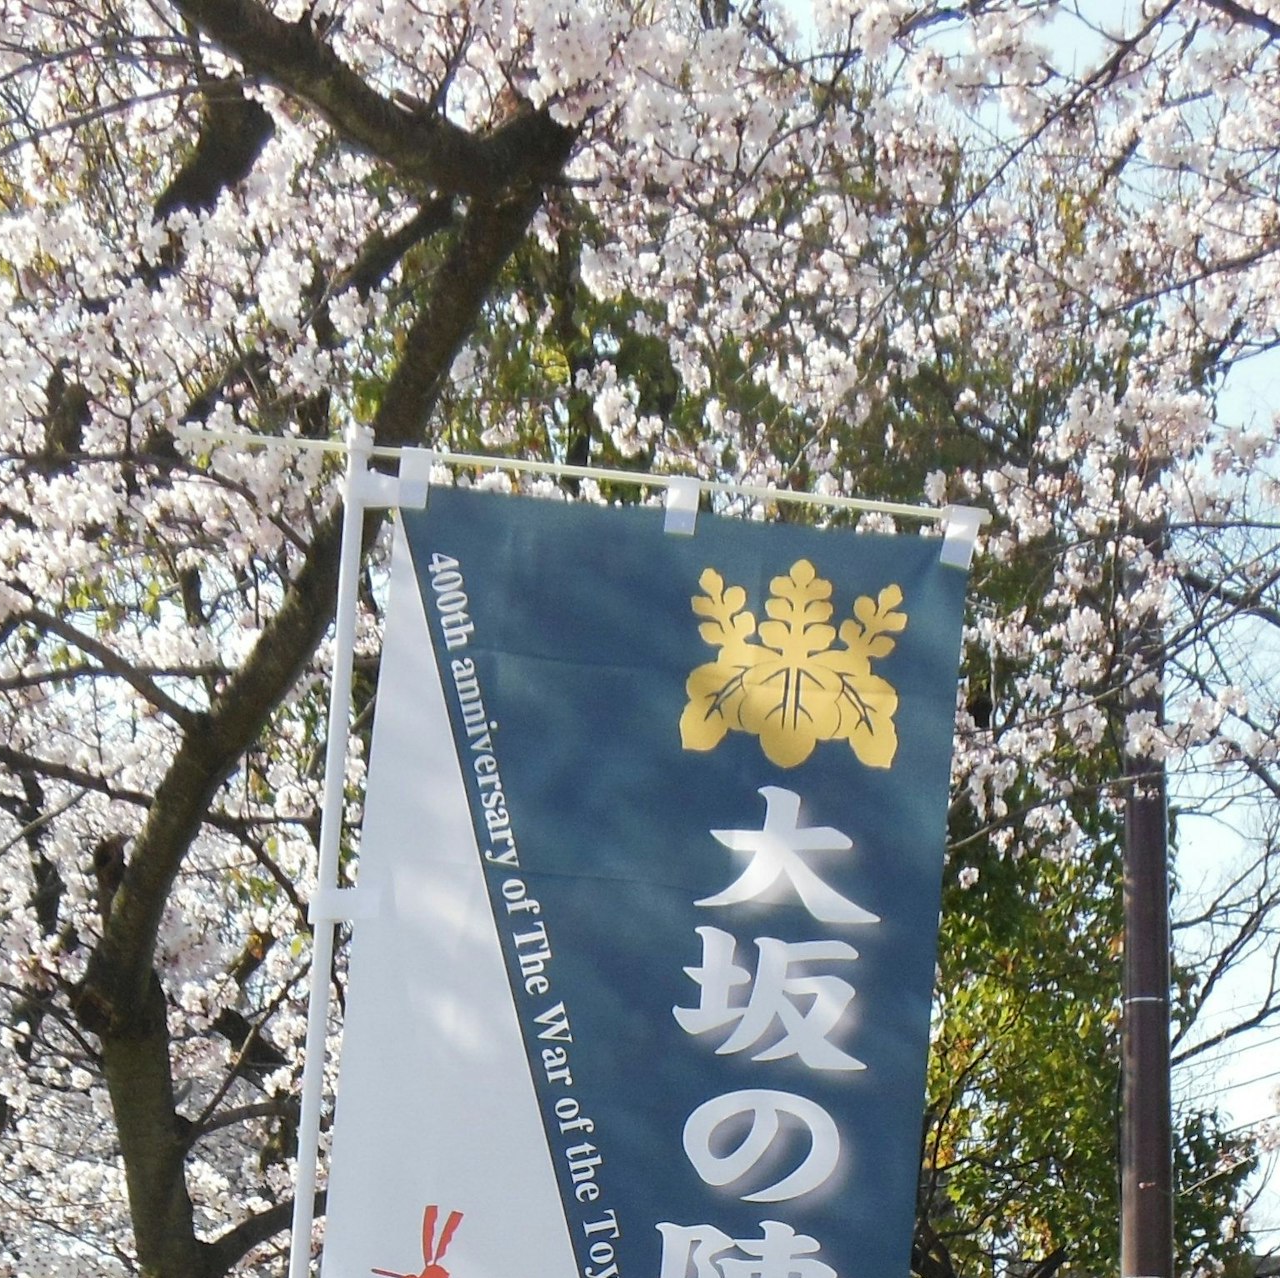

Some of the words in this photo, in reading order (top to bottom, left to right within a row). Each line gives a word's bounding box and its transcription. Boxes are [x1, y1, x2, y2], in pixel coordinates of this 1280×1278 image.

[428, 552, 475, 652] 400th
[451, 657, 520, 868] anniversary
[502, 878, 541, 915] of
[513, 920, 552, 996] The
[533, 1000, 573, 1086] War
[554, 1097, 595, 1135] of
[565, 1141, 603, 1203] the
